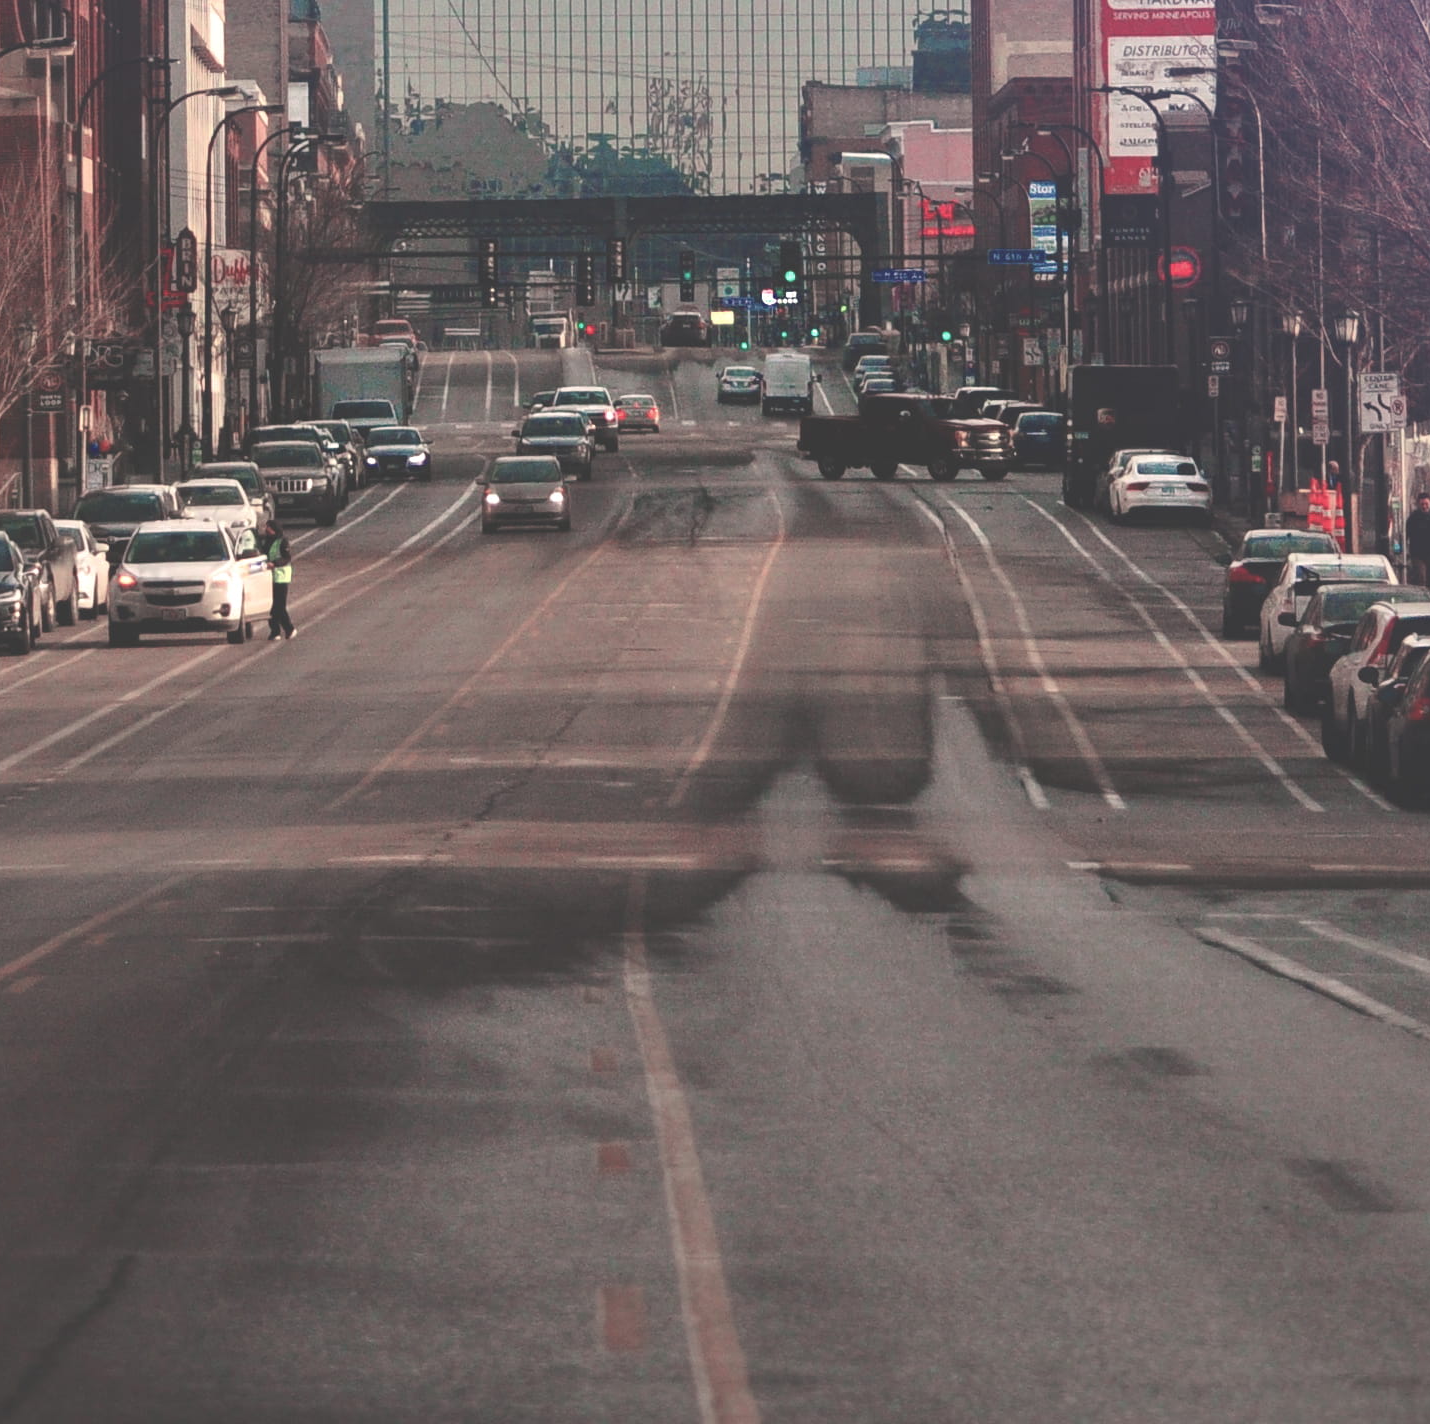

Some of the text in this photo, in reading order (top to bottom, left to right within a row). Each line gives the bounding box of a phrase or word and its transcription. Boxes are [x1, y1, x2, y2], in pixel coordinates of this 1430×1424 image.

[1113, 11, 1210, 20] SERVING MINNEAPOLIS
[1123, 45, 1216, 57] DISTRIBUTORS
[182, 238, 192, 286] BRIN
